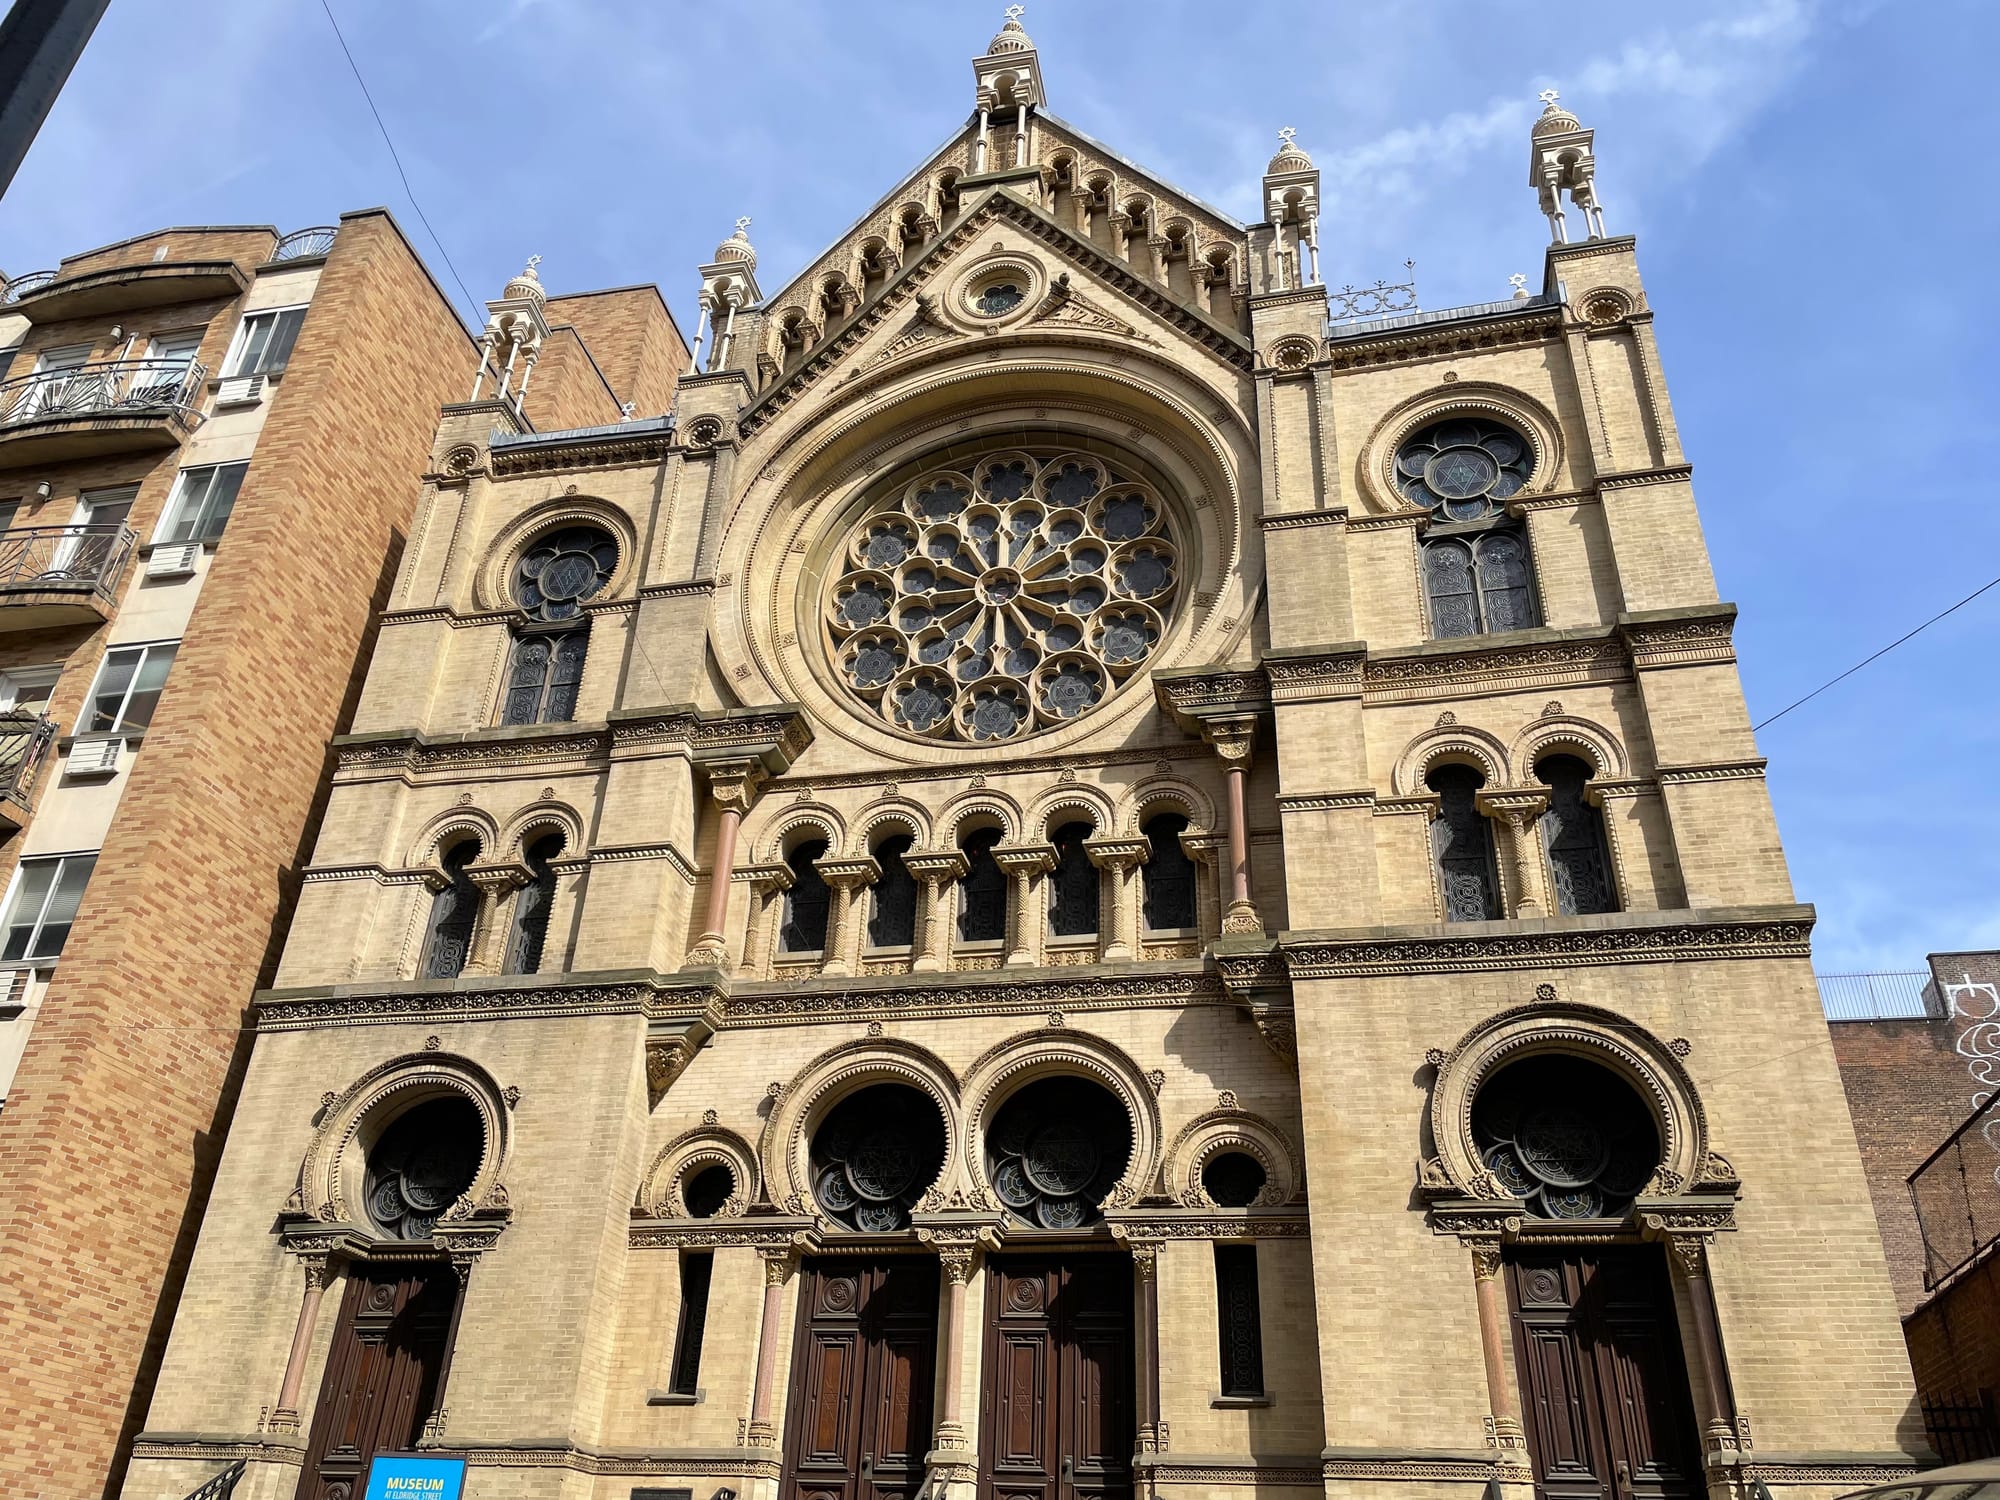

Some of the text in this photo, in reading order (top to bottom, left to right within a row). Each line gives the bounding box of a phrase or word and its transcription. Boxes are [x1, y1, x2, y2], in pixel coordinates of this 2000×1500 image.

[387, 1477, 444, 1491] MUSEUM
[384, 1491, 442, 1500] AT ELDRIDGE STREET
